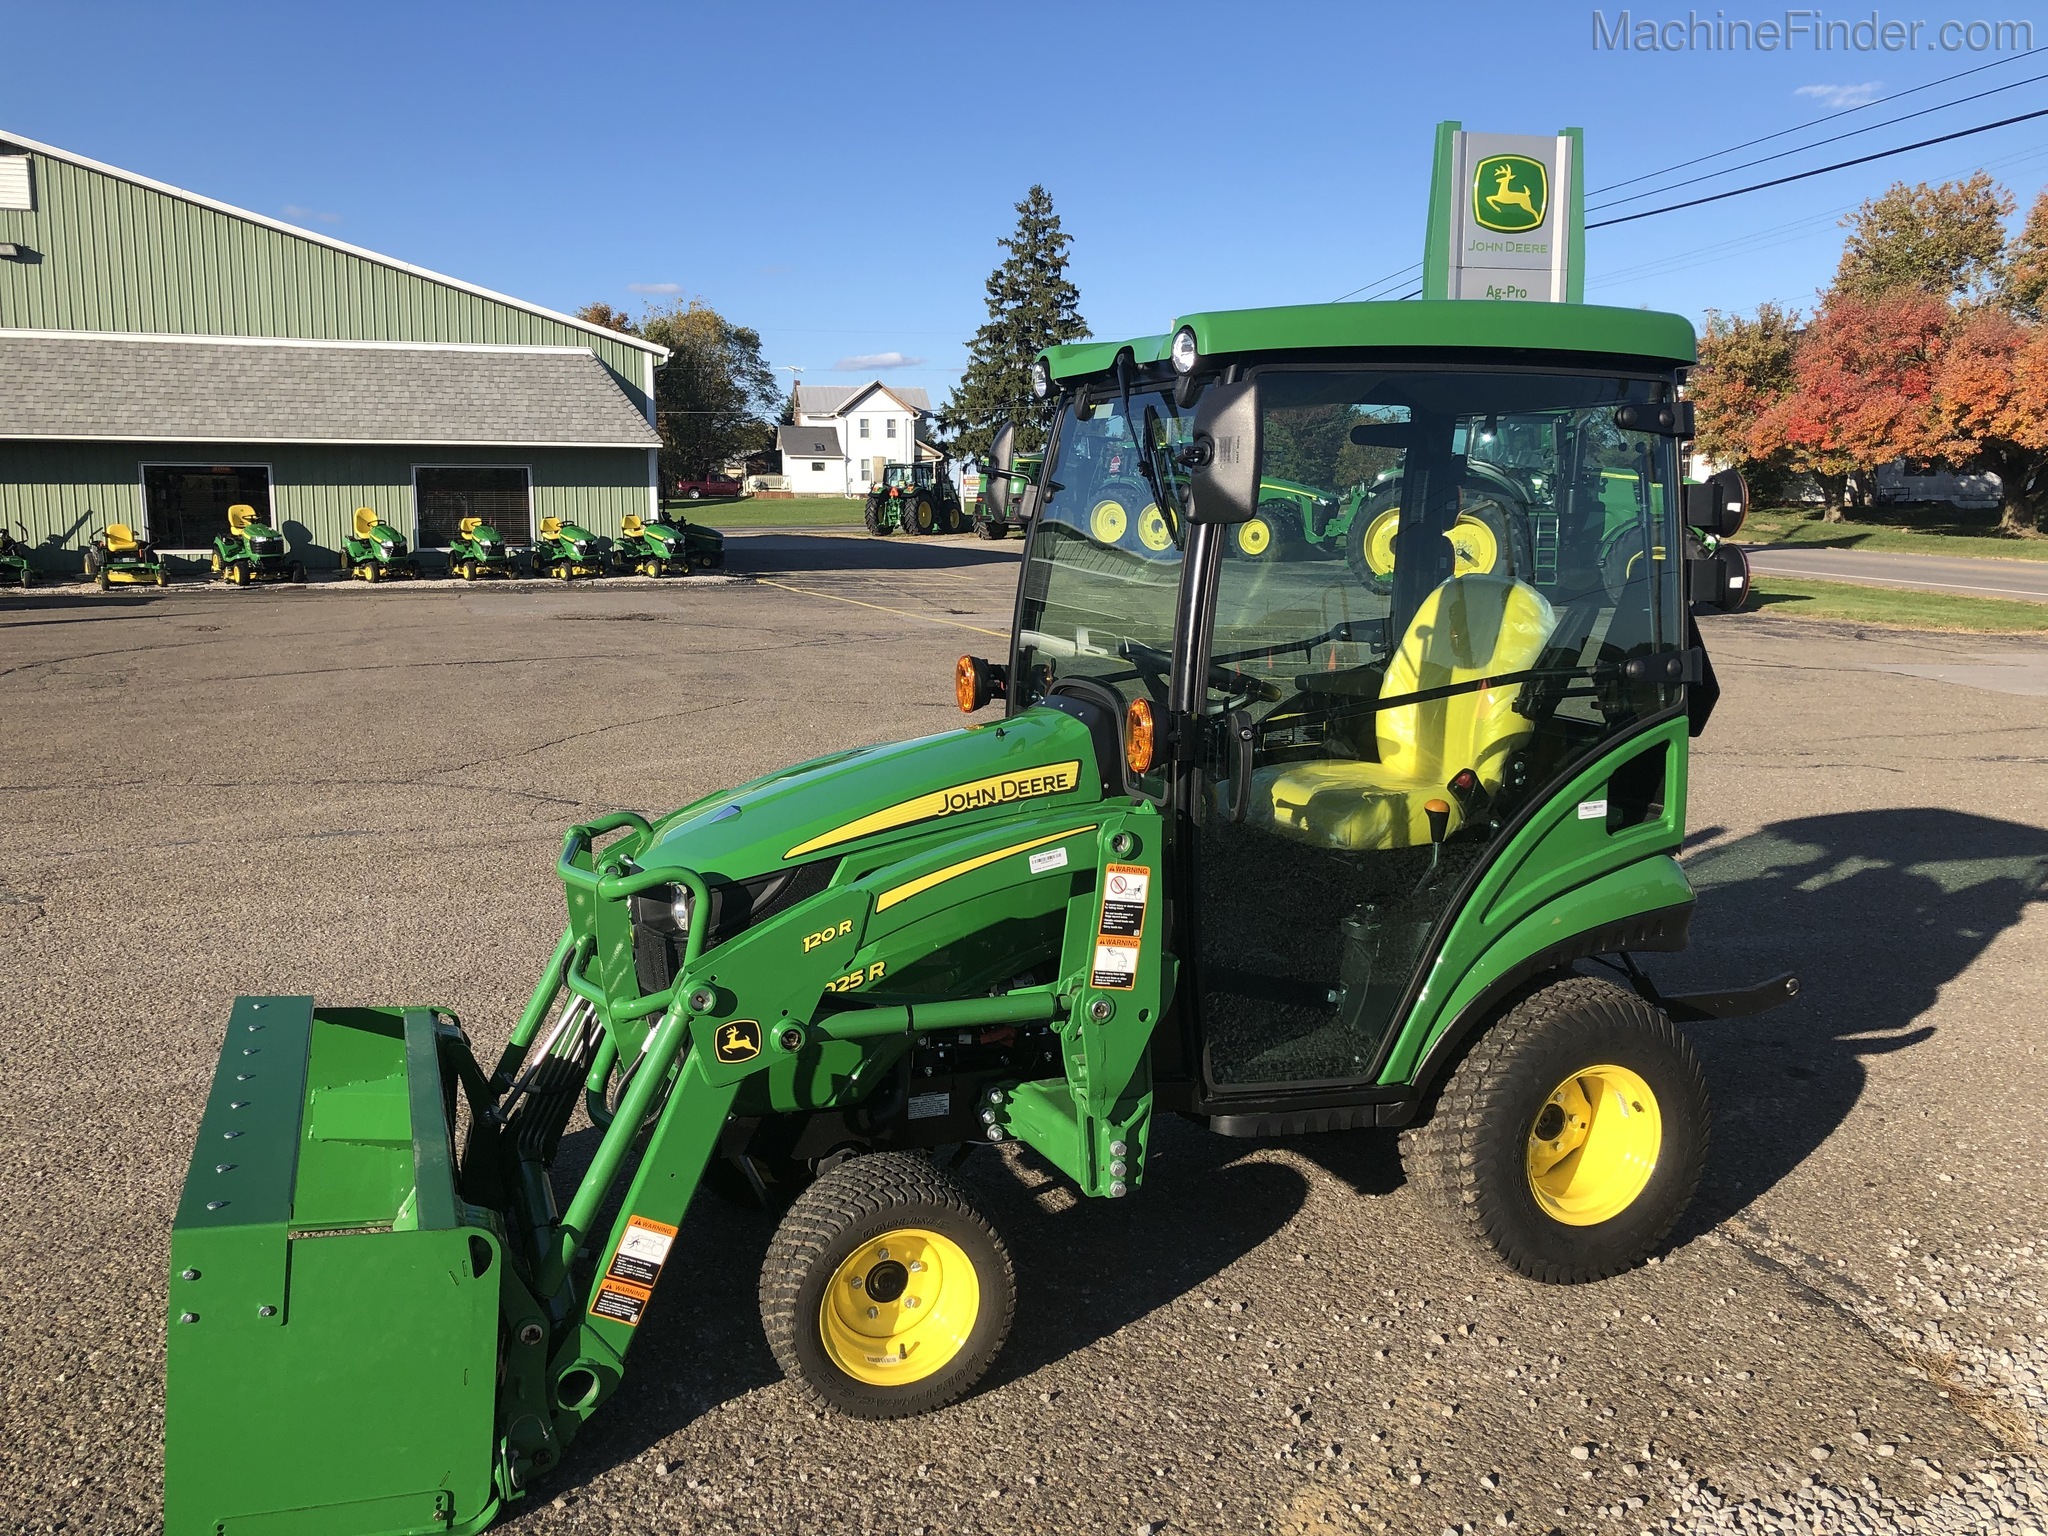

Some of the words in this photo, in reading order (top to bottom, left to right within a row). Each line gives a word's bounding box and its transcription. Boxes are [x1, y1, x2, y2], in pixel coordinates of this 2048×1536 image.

[1468, 240, 1503, 252] JOHN
[1505, 241, 1548, 254] DEERE
[1486, 285, 1527, 300] Ag-Pro
[937, 786, 996, 814] JOHN
[1001, 773, 1069, 799] DEERE
[1115, 865, 1148, 875] WARNING
[803, 926, 836, 954] 120
[838, 919, 853, 937] R
[1105, 937, 1138, 947] WARNING
[868, 961, 886, 982] R
[642, 1220, 673, 1235] WARNING
[615, 1284, 646, 1299] WARNING
